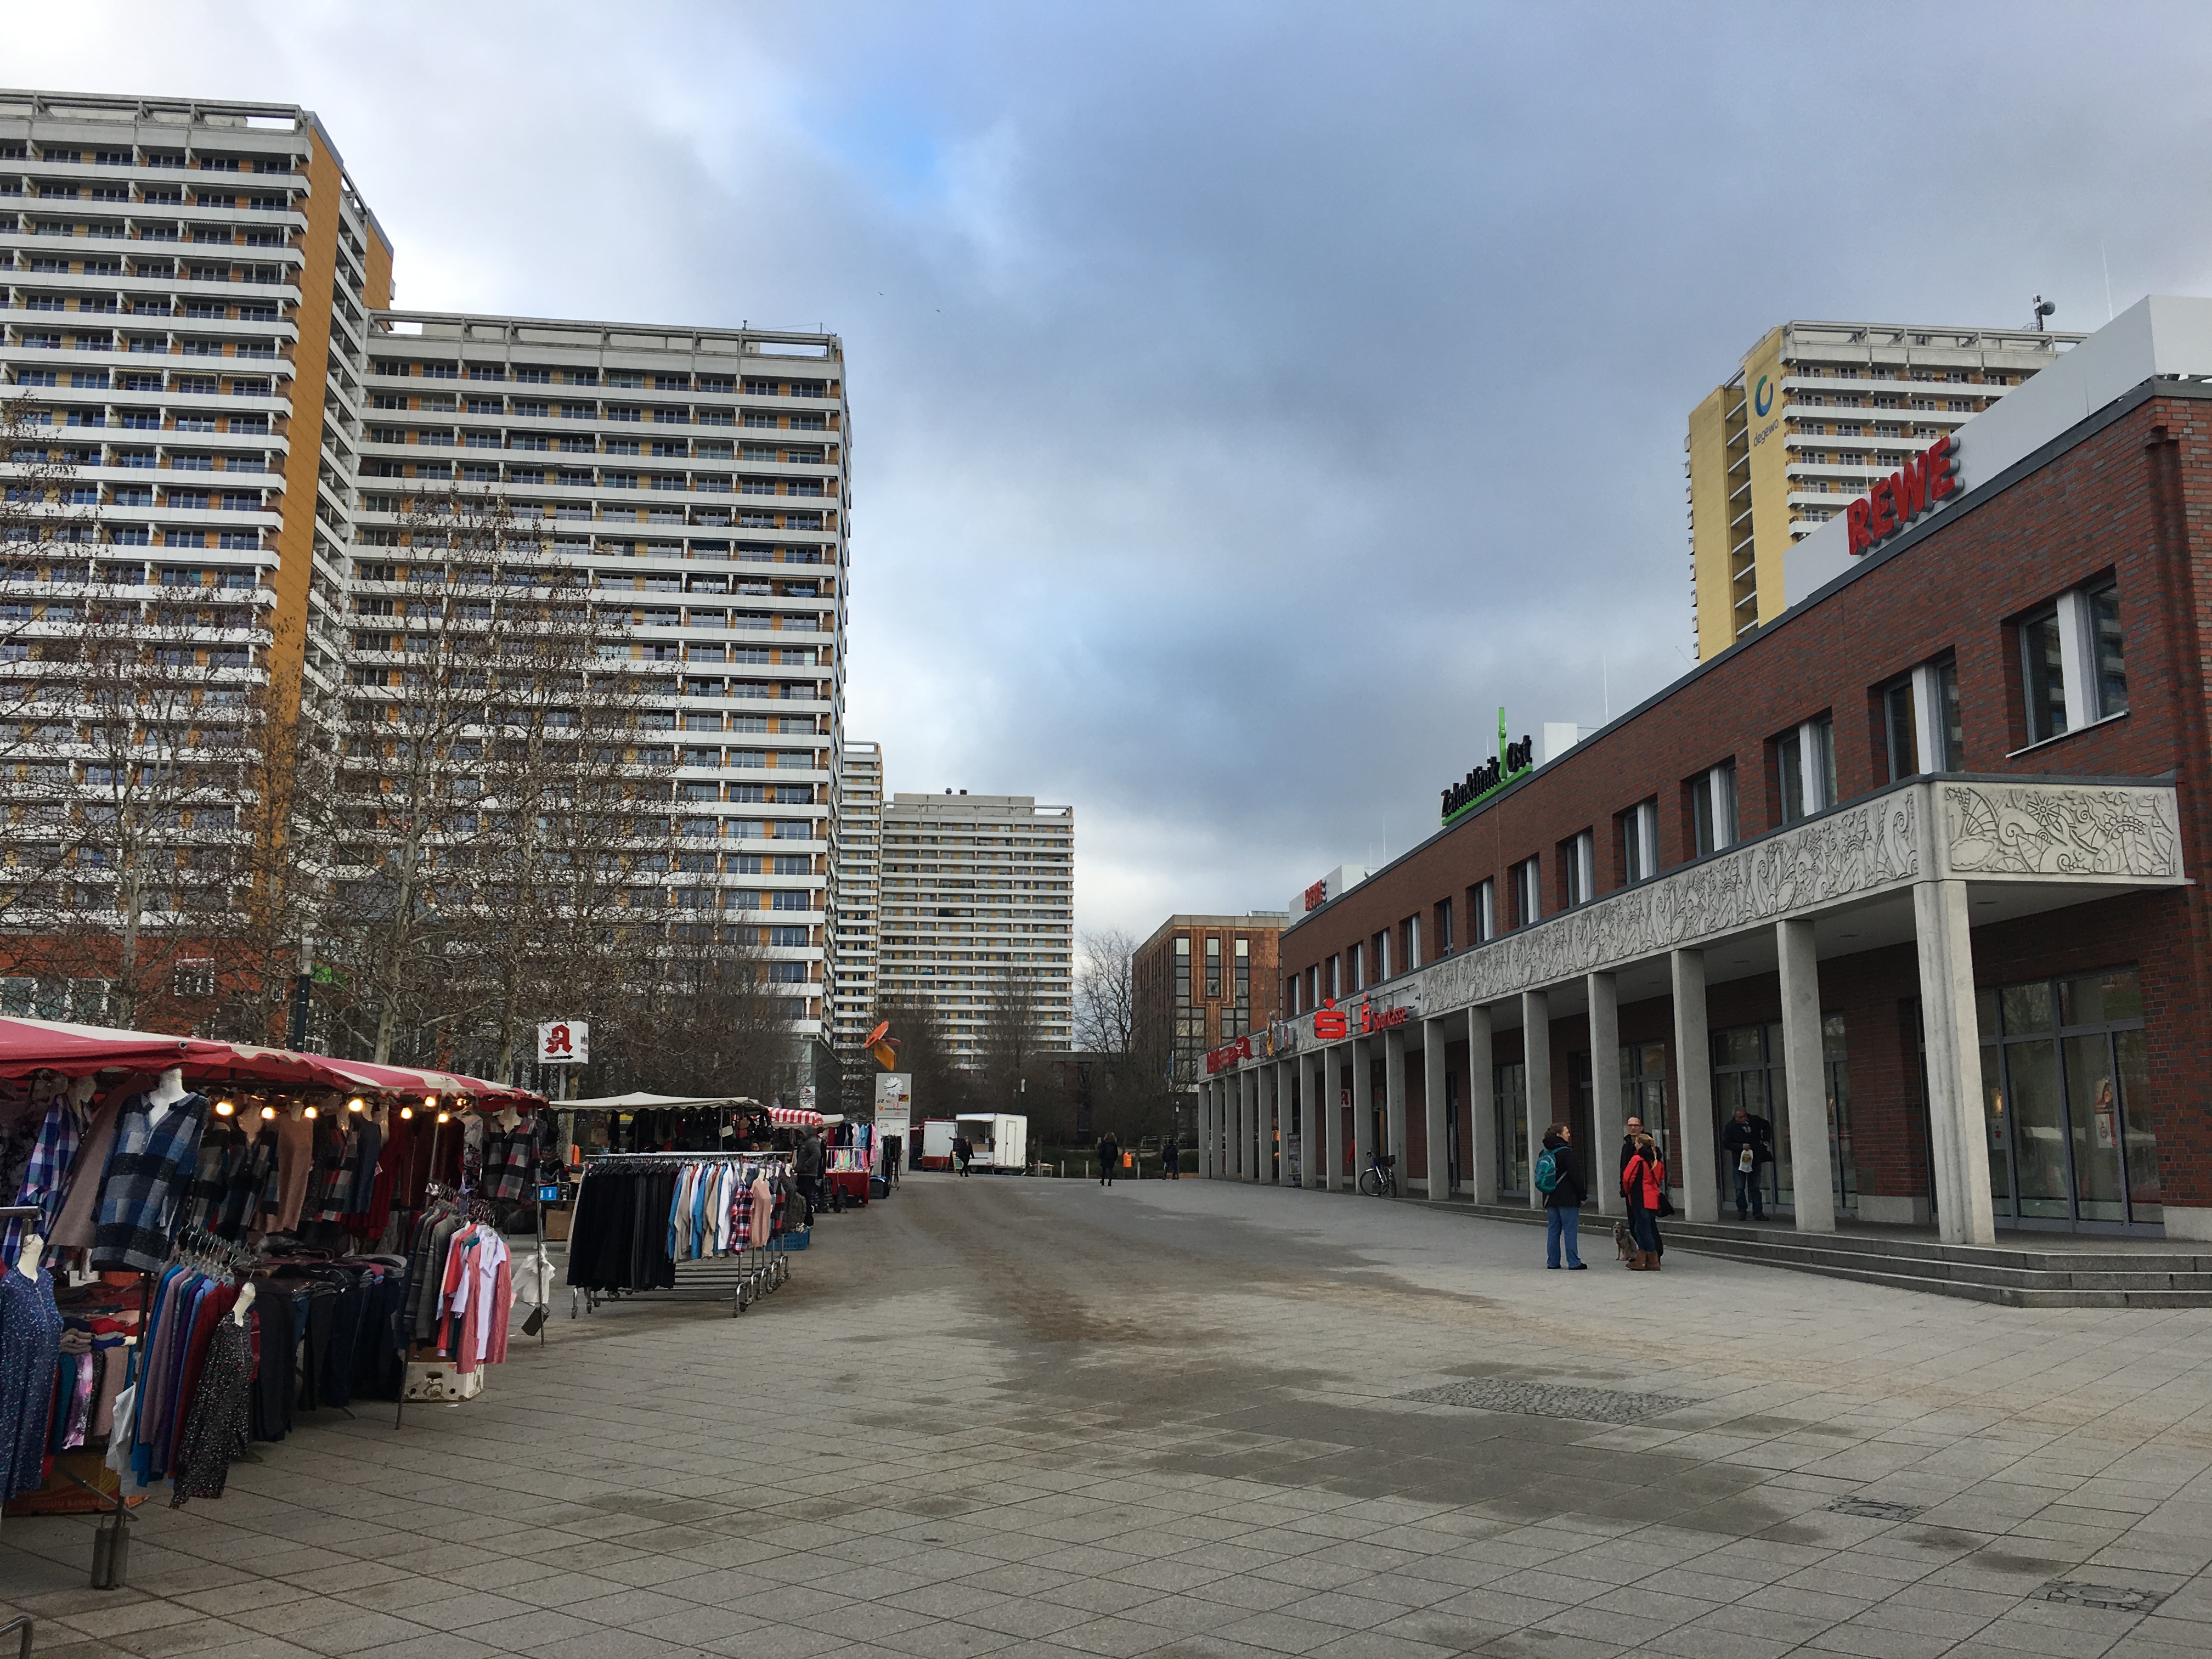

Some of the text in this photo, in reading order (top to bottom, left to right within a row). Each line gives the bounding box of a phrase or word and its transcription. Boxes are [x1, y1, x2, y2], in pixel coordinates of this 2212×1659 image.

[1754, 419, 1779, 447] degewo
[1847, 436, 1960, 555] REWE
[1441, 735, 1532, 817] Zahnklinik Ost
[1305, 879, 1323, 912] REWE
[1373, 1005, 1407, 1035] Sparkasse
